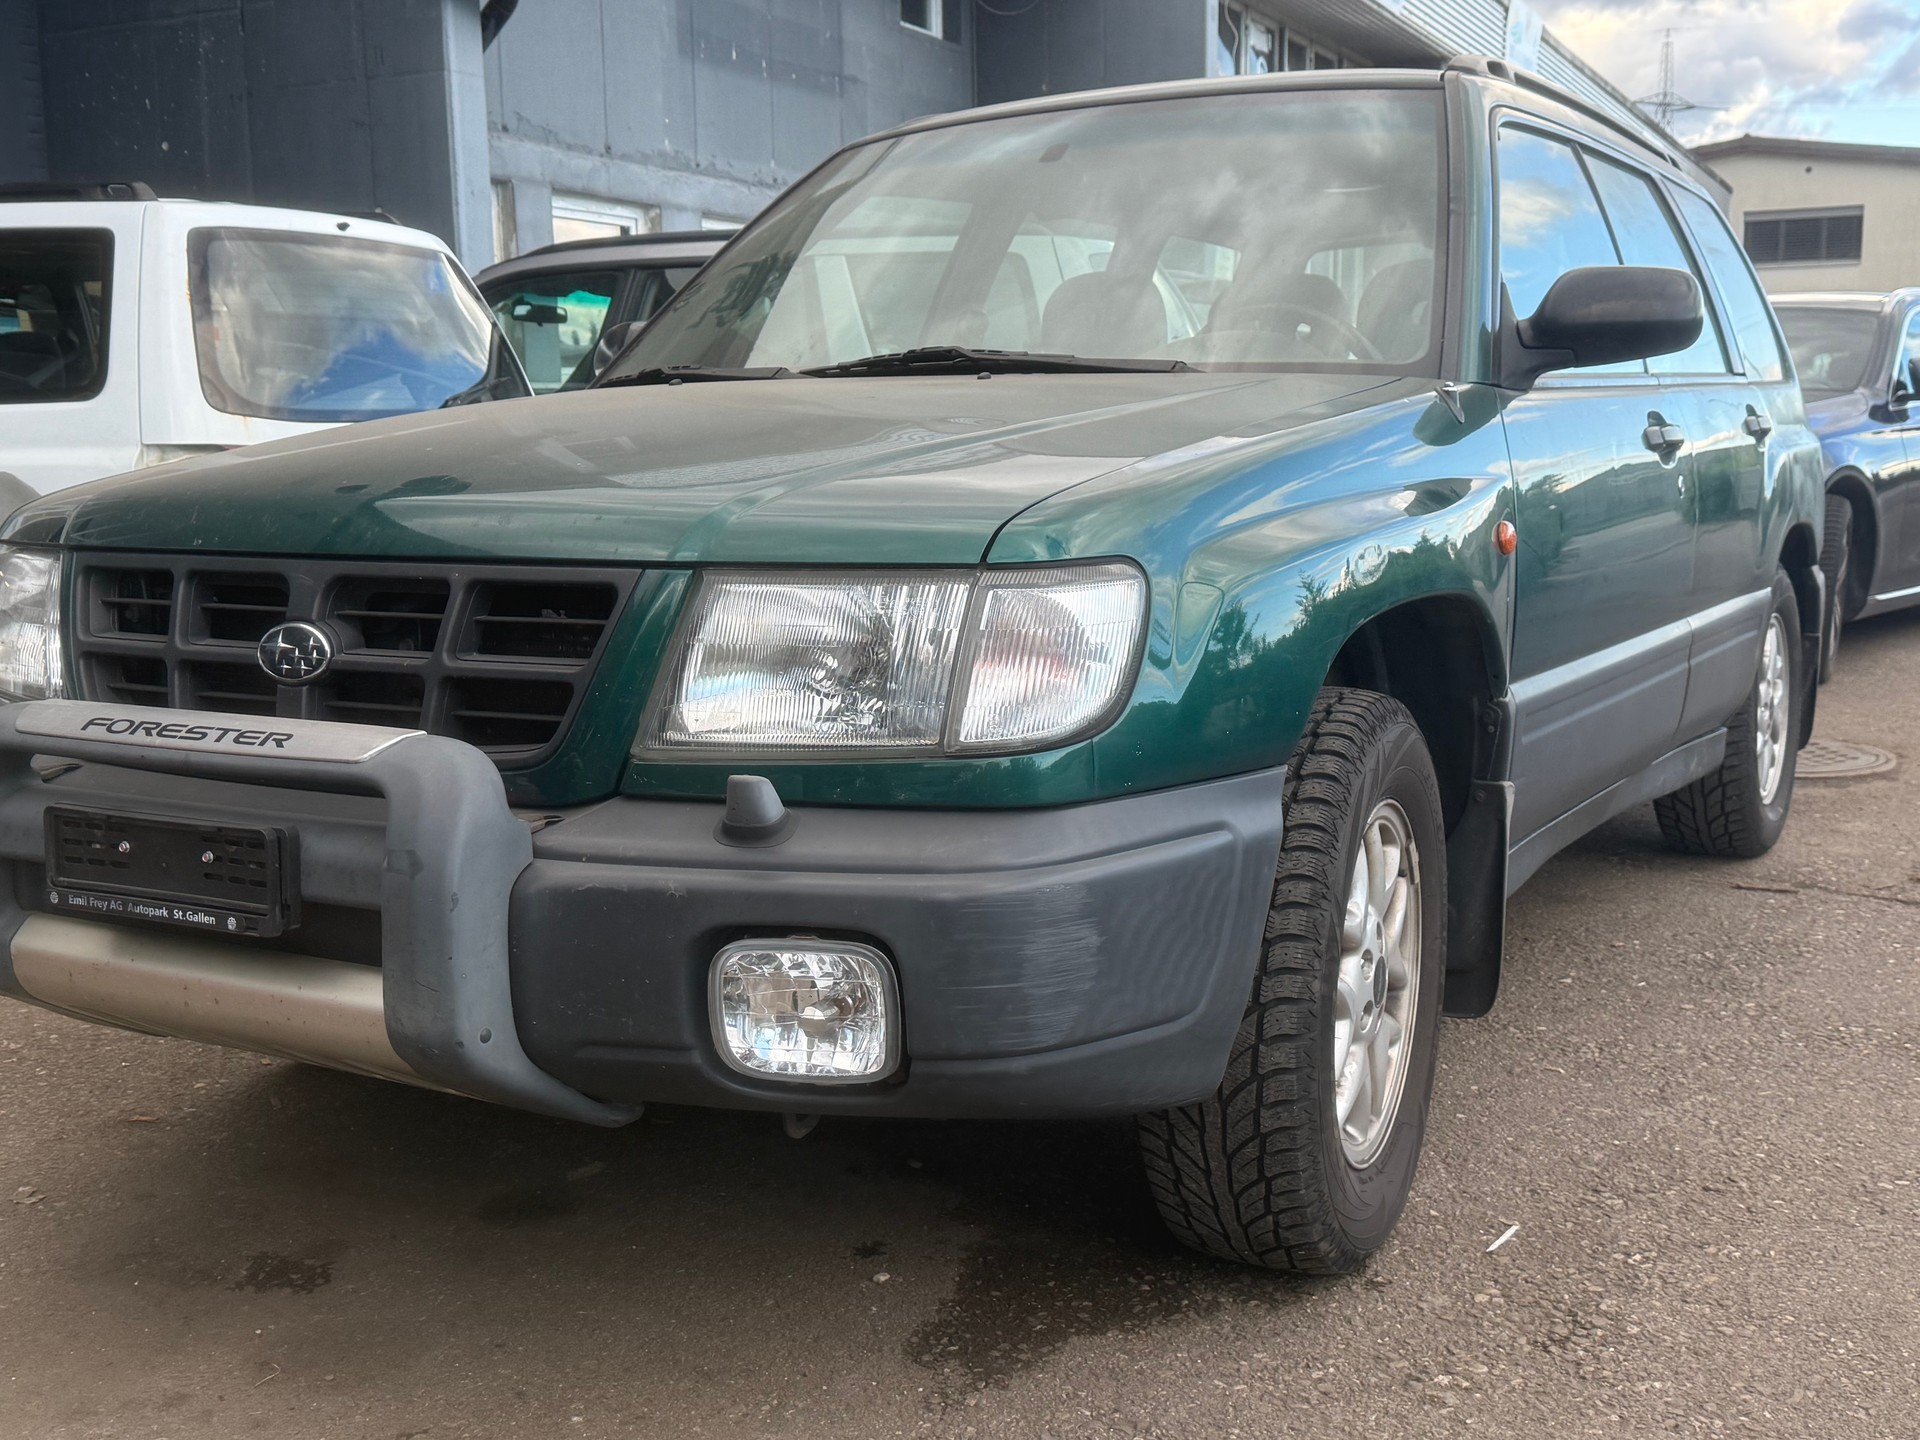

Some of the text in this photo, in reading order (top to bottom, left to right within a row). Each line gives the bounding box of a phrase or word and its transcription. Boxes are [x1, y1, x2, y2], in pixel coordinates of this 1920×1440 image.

[80, 717, 294, 748] FORESTER
[68, 894, 216, 925] Emil Frey AG Autopark St.Gallen
